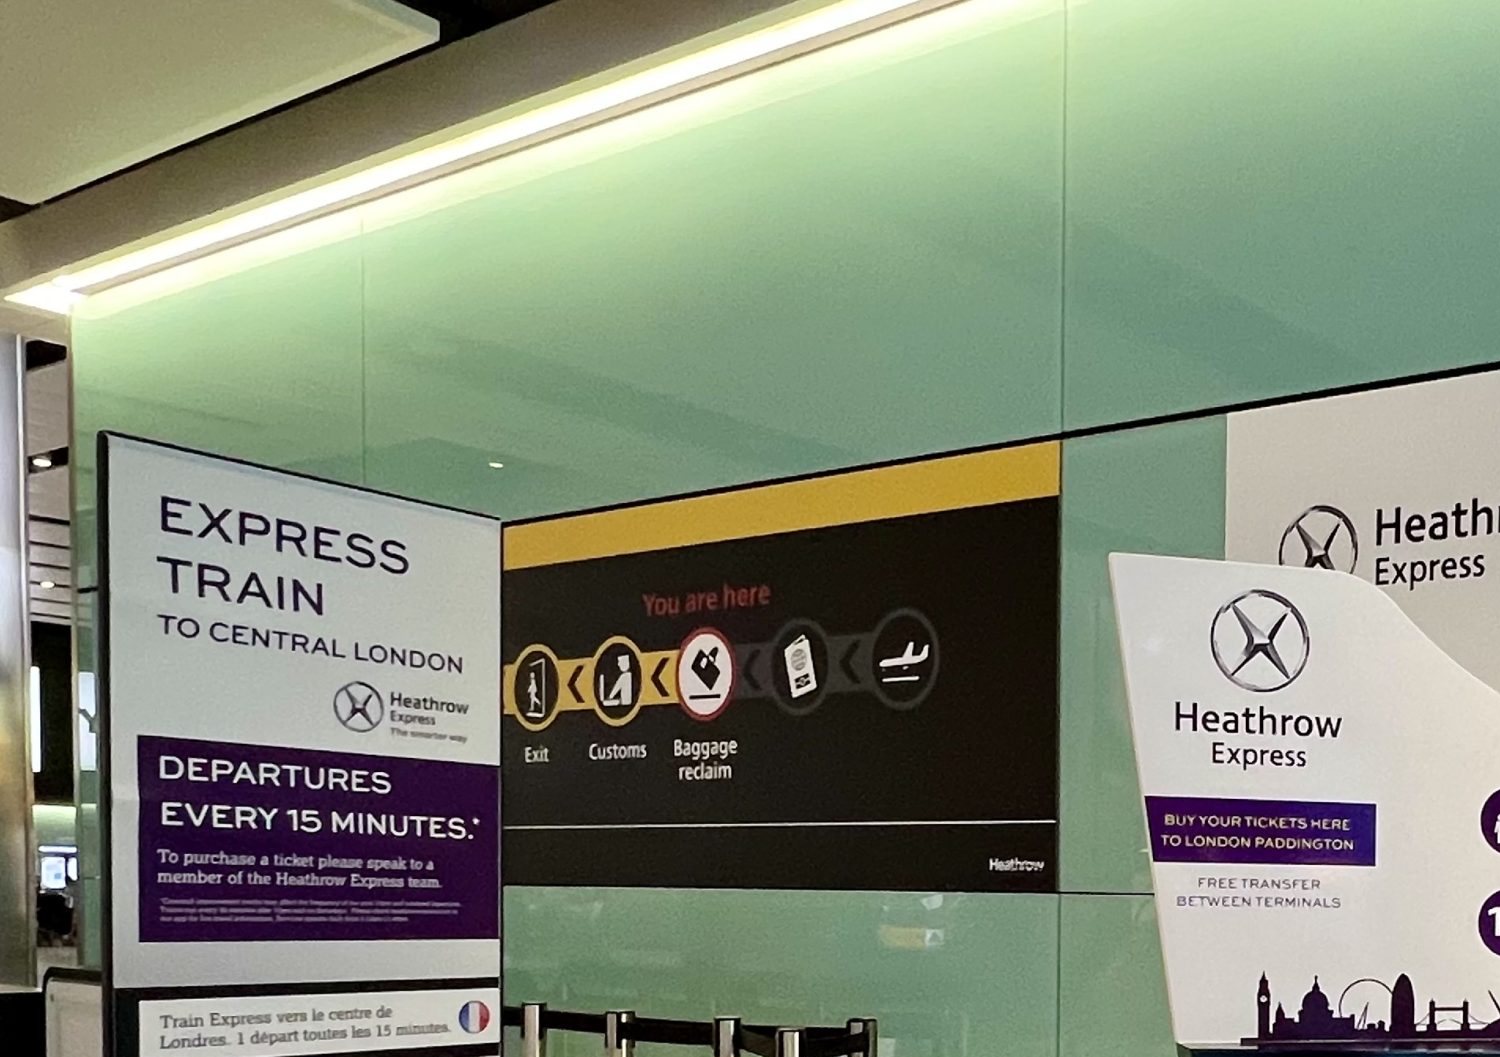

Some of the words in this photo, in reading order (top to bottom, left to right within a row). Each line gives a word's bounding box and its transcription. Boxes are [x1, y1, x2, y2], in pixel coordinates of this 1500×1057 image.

[160, 496, 409, 575] EXPRESS
[1375, 554, 1485, 590] Express
[157, 556, 324, 616] TRAIN
[643, 594, 678, 617] You
[684, 591, 718, 612] are
[722, 584, 771, 608] here
[158, 614, 199, 638] TO
[209, 622, 345, 658] CENTRAL
[355, 642, 463, 674] LONDON
[390, 692, 468, 715] Heathrow
[390, 711, 436, 727] Express
[1175, 701, 1342, 738] Heathrow
[524, 745, 549, 763] Exit
[589, 741, 647, 761] Customs
[673, 738, 738, 759] Baggage
[1211, 742, 1307, 771] Express
[159, 755, 391, 794] DEPARTURES
[678, 762, 732, 781] reclaim
[161, 802, 278, 829] EVERY
[287, 809, 321, 833] 15
[1164, 814, 1194, 826] BUY
[1198, 814, 1242, 828] YOUR
[1244, 815, 1308, 830] TICKETS
[1310, 818, 1350, 831] HERE
[1161, 834, 1182, 848] TO
[1185, 835, 1250, 849] LONDON
[1254, 836, 1354, 851] PADDINGTON
[158, 849, 180, 865] To
[184, 851, 255, 869] purchase
[260, 856, 269, 866] a
[274, 853, 313, 868] ticket
[319, 855, 363, 873] please
[367, 857, 406, 874] speak
[410, 859, 423, 871] to
[426, 861, 434, 871] a
[989, 857, 1044, 873] Heathrow
[158, 872, 222, 885] member
[228, 871, 243, 886] of
[248, 872, 271, 886] the
[276, 872, 346, 887] Heathrow
[351, 873, 404, 890] Express
[1198, 877, 1237, 889] FREE
[1241, 878, 1320, 890] TRANSFER
[1176, 896, 1251, 908] BETWEEN
[1255, 896, 1341, 908] TERMINALS
[160, 1015, 203, 1029] Train
[210, 1012, 270, 1028] Express
[277, 1011, 307, 1022] vers
[312, 1010, 324, 1021] le
[329, 1007, 372, 1020] centre
[376, 1006, 392, 1018] de
[238, 1032, 244, 1045] 1
[250, 1027, 298, 1046] départ
[303, 1026, 347, 1040] toutes
[352, 1025, 370, 1038] les
[376, 1024, 391, 1037] 15
